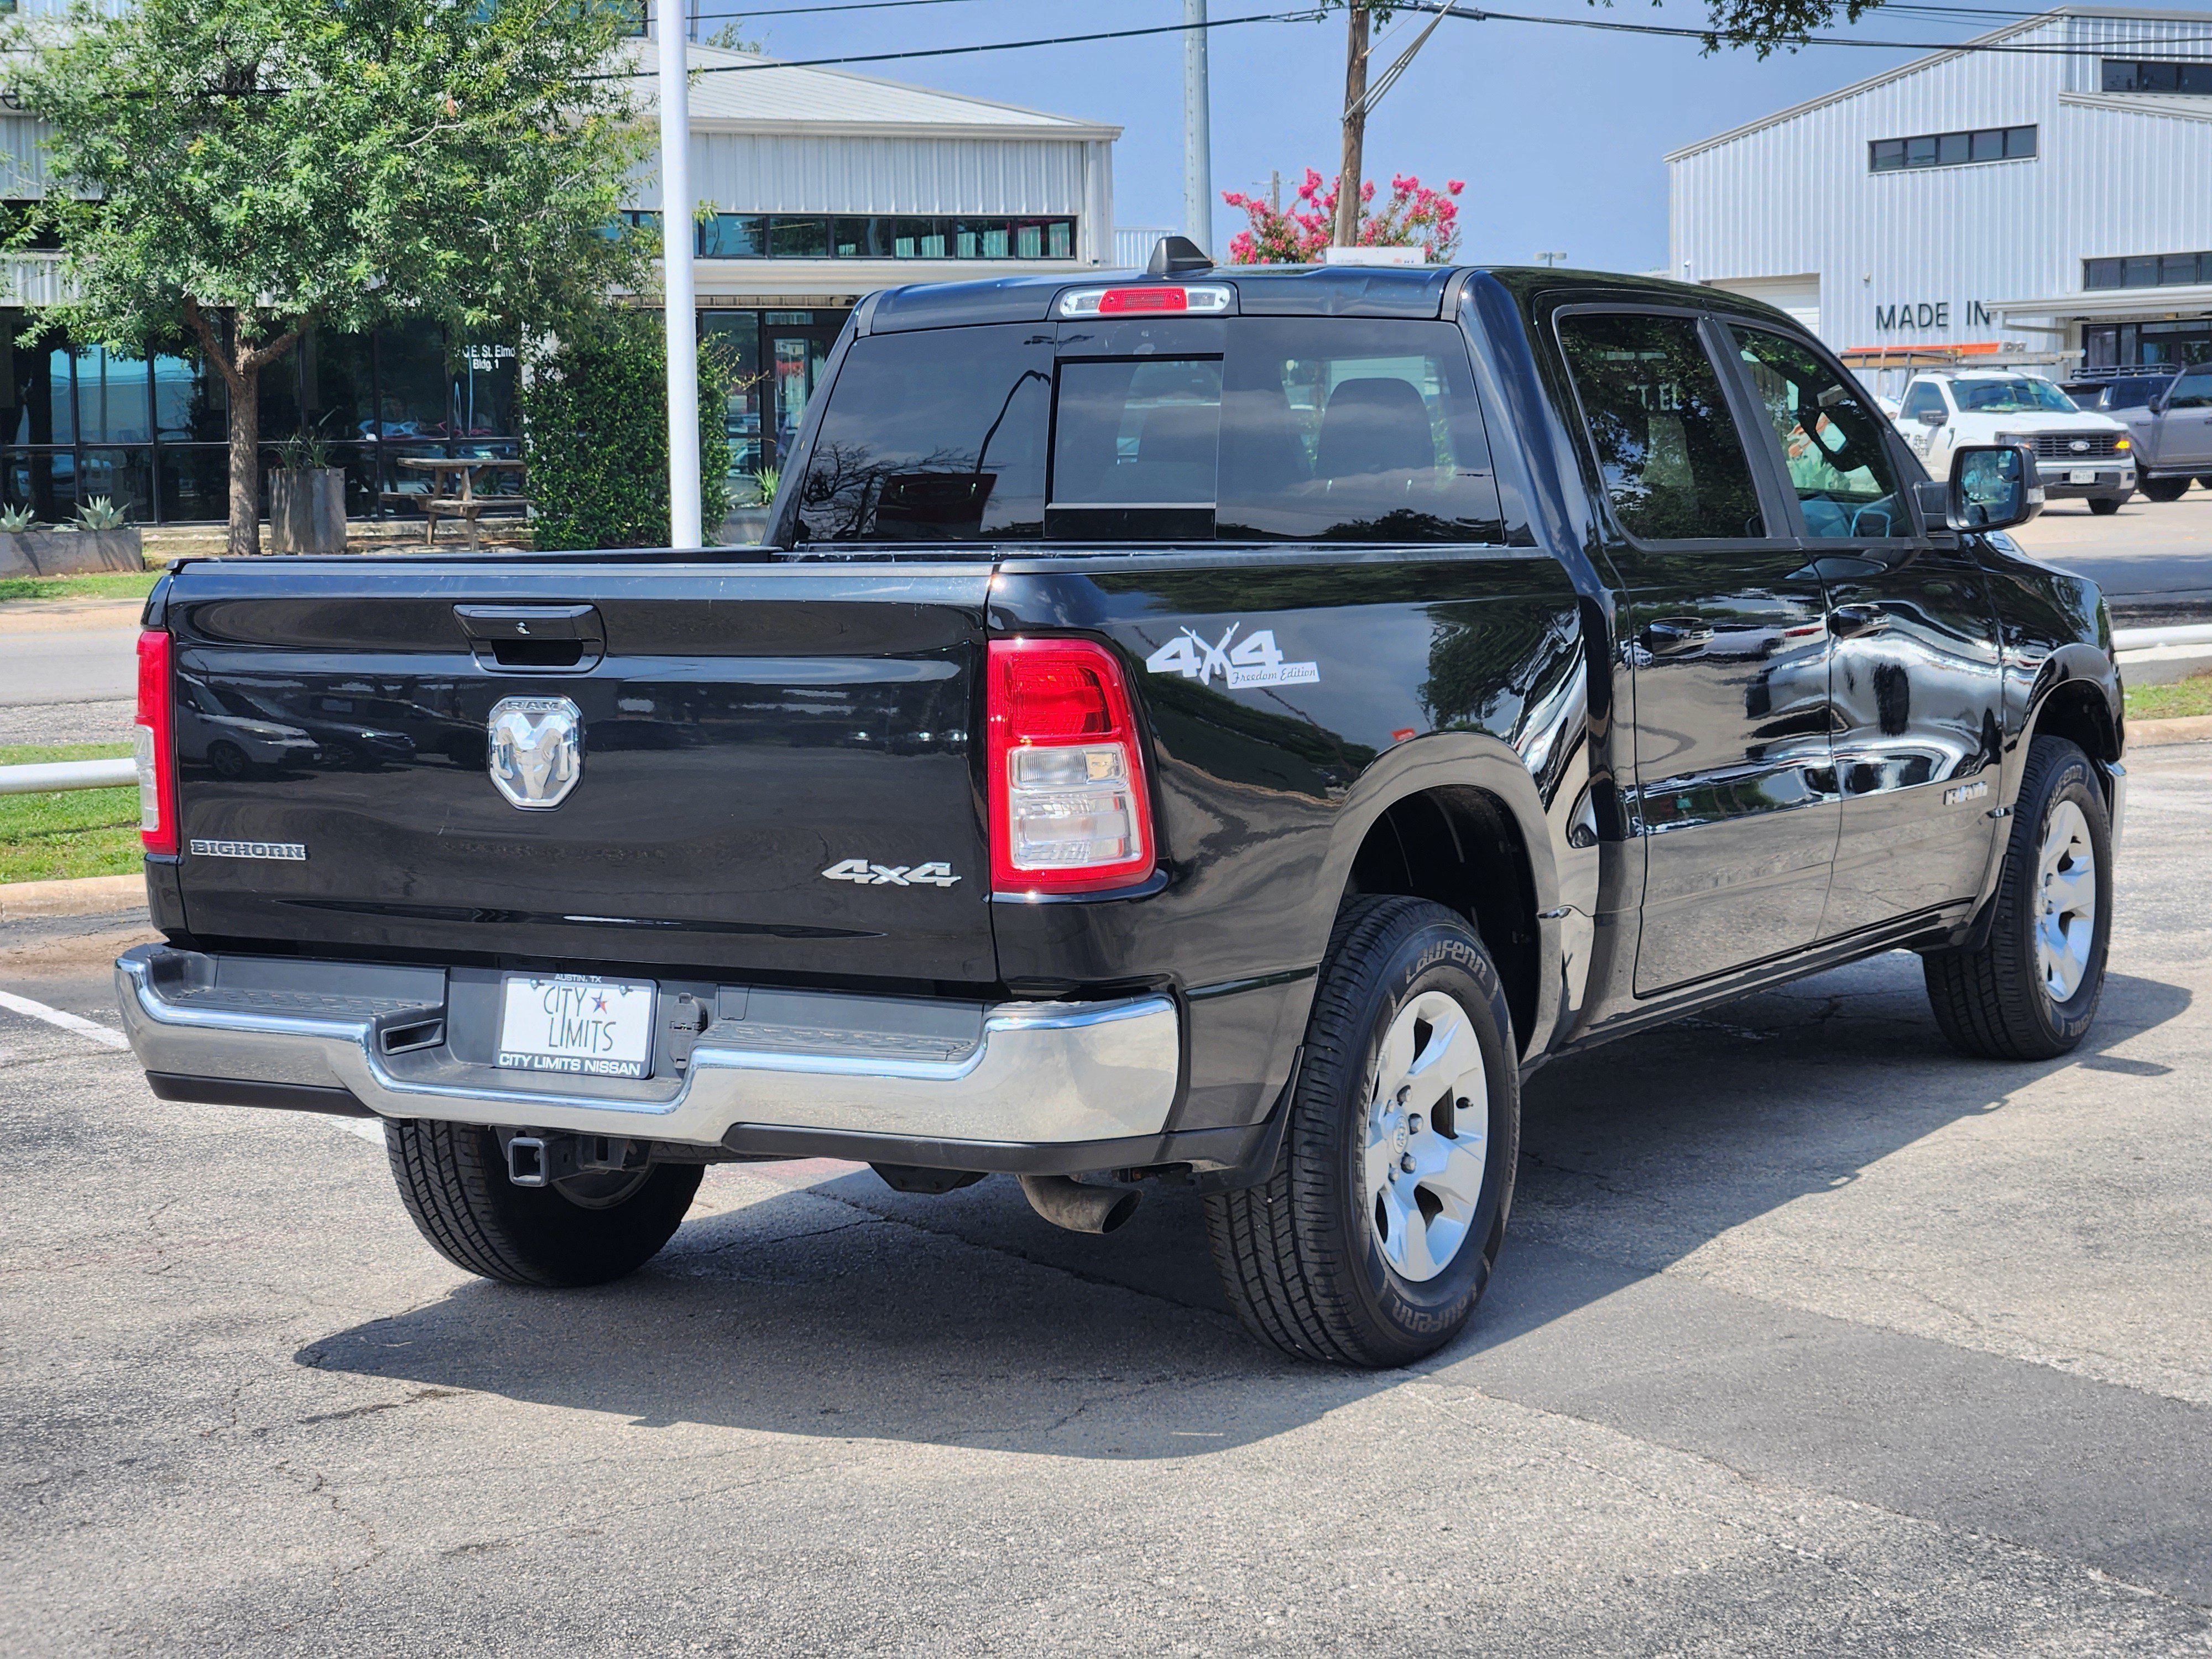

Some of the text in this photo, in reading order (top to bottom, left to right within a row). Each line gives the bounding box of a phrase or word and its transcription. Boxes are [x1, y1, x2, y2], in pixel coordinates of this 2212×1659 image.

[1876, 300, 1990, 330] MADE IN
[494, 344, 515, 358] Elmo
[494, 358, 499, 369] 1
[1231, 667, 1316, 684] Freedom Edition
[505, 701, 560, 711] RAM
[1943, 781, 1988, 806] RAM
[190, 839, 306, 861] BIGHORN
[821, 859, 962, 887] 4x4
[589, 975, 602, 983] TX
[544, 986, 587, 1022] CITY
[549, 1014, 617, 1053] LIMITS
[499, 1053, 641, 1076] CITY LIMITS NISSAN
